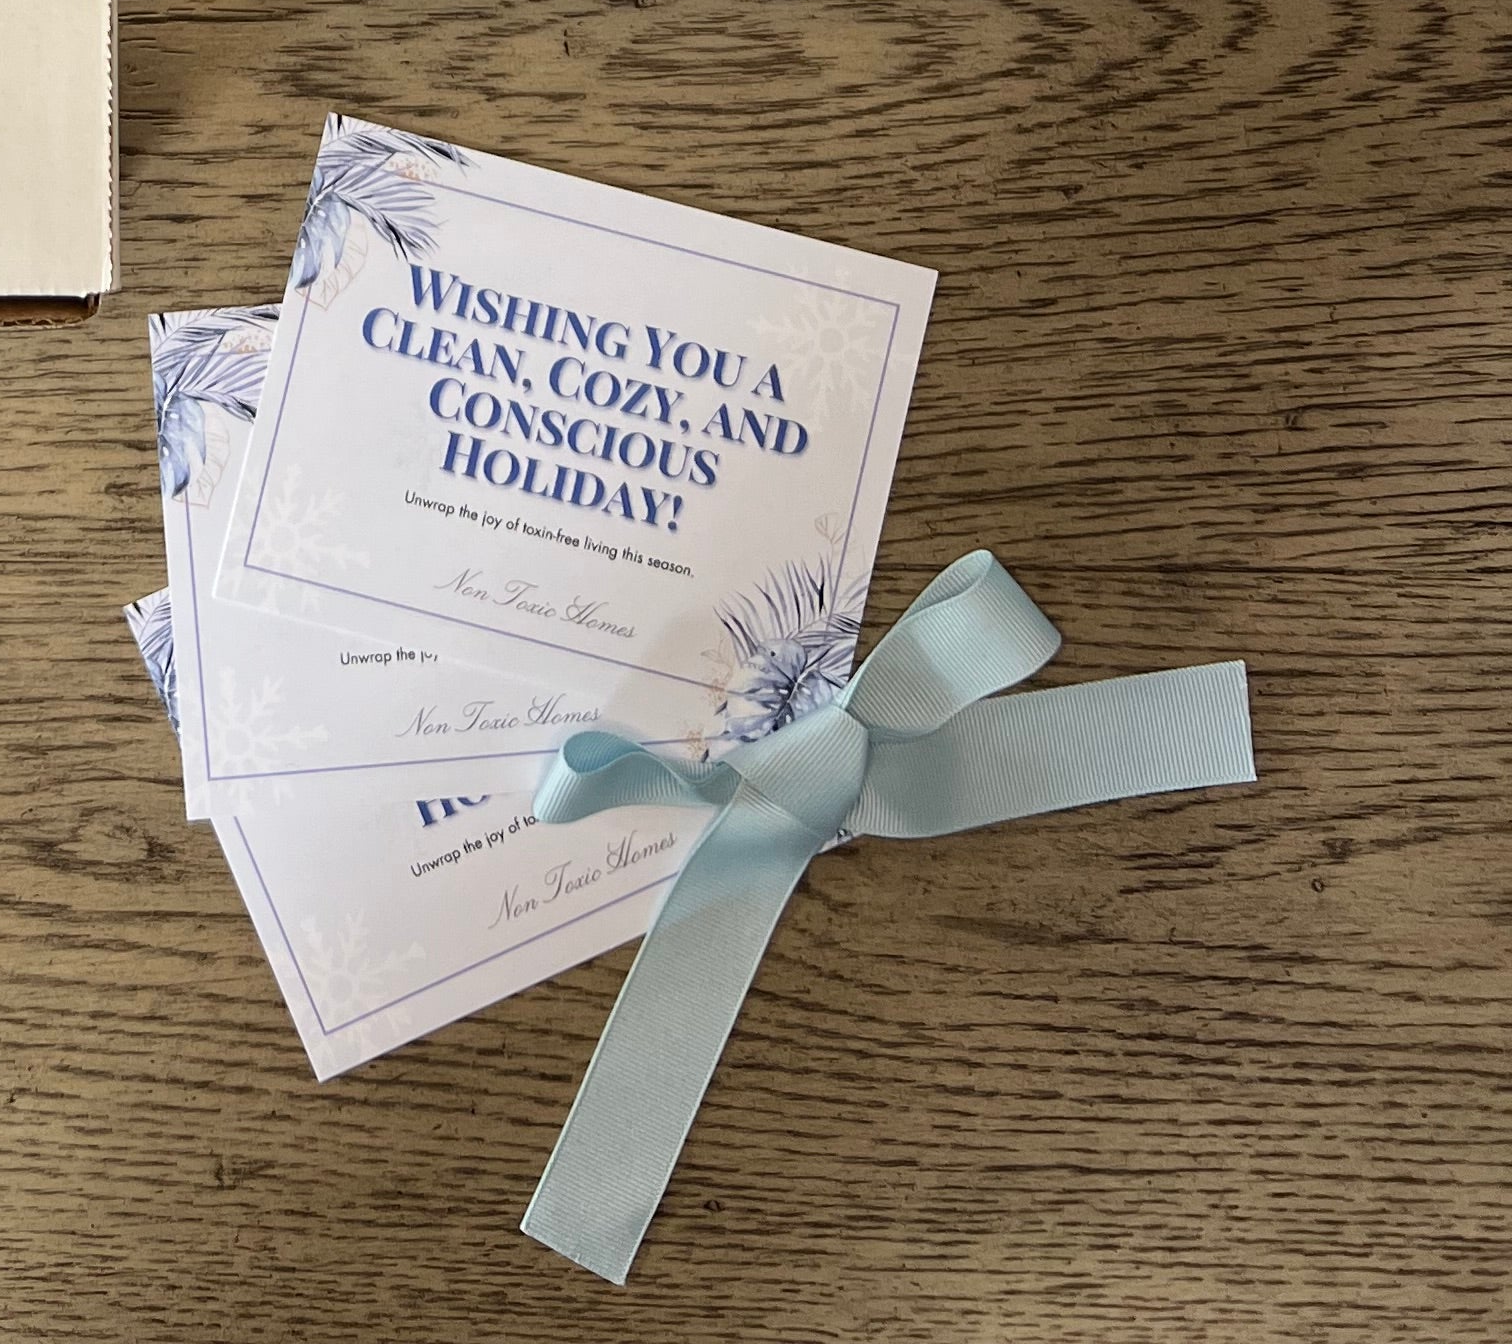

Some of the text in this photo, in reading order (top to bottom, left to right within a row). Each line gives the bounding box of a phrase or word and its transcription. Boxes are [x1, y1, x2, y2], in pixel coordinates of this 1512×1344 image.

[408, 263, 785, 403] WISHING YOU A
[362, 307, 809, 455] CLEAN, COZY, AND
[429, 377, 721, 486] CONSCIOUS
[438, 431, 685, 531] HOLIDAY!
[405, 489, 694, 578] Unwrap the joy of toxin-free living this season.
[434, 568, 637, 639] Non Toxic Homes
[340, 651, 392, 666] Unwrap
[396, 646, 416, 661] the
[395, 693, 601, 738] Non Toxic Homes
[410, 847, 461, 877] Unwrap
[463, 838, 483, 854] the
[485, 828, 504, 848] joy
[507, 816, 521, 833] of
[488, 830, 678, 930] Non Toxic Homes
